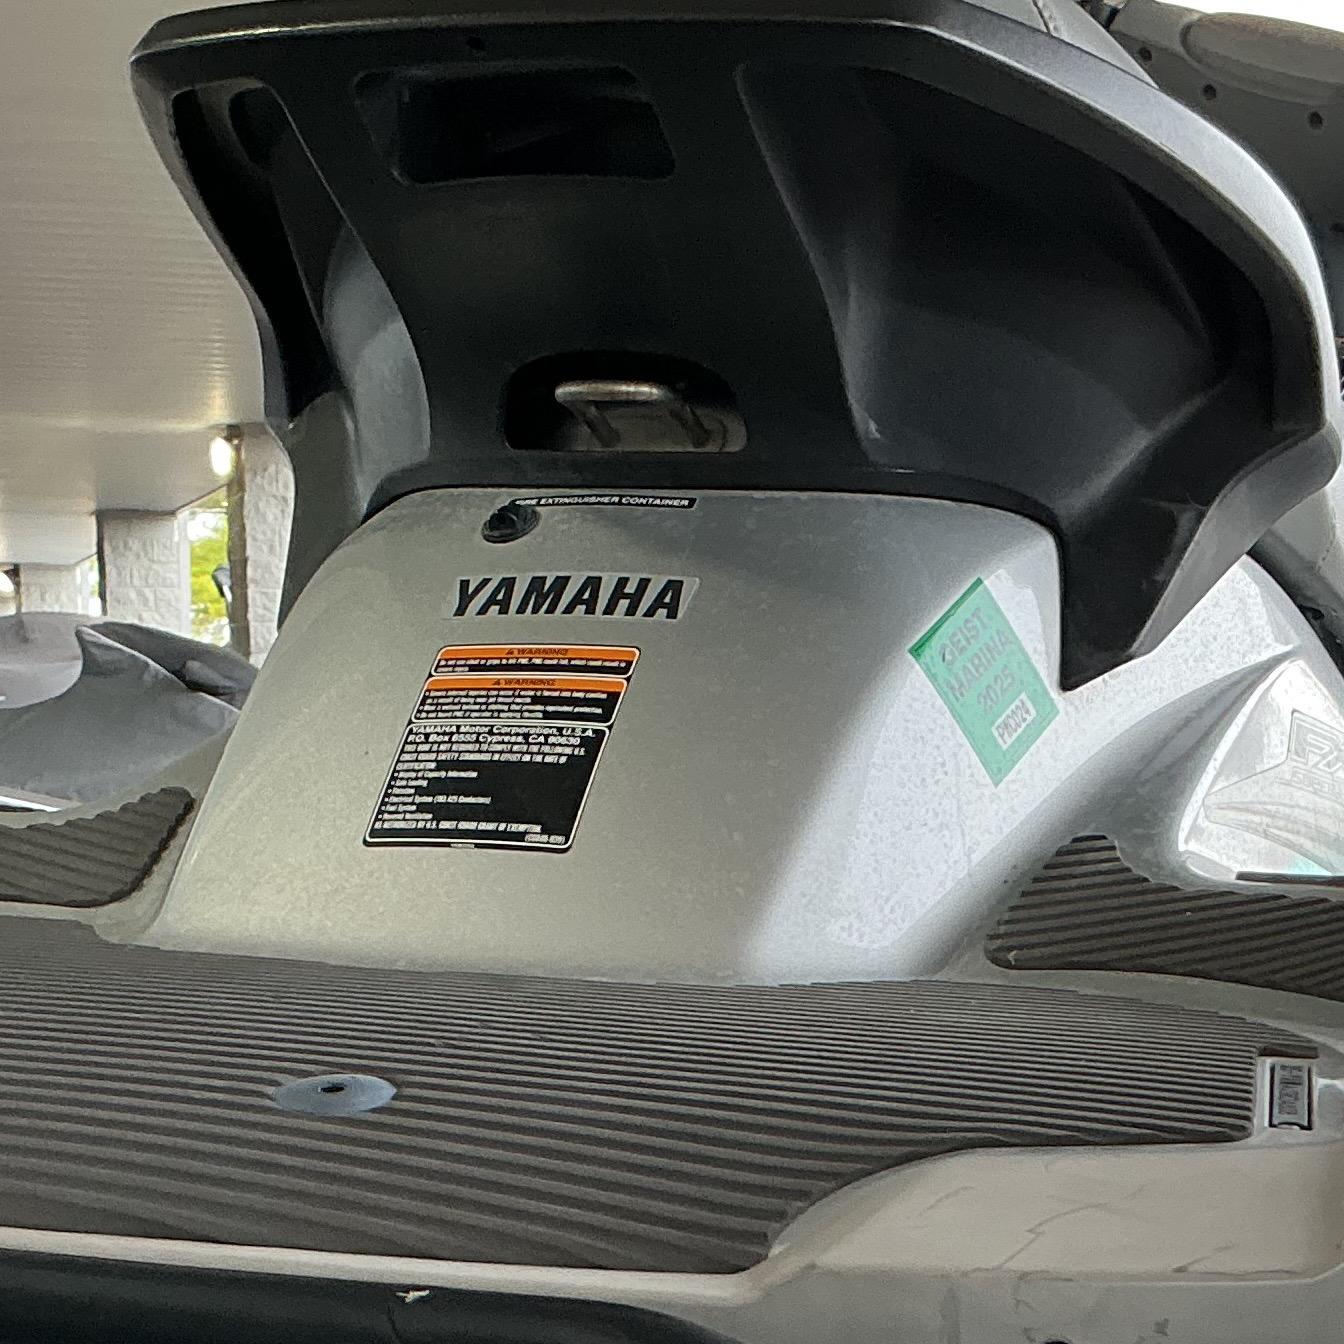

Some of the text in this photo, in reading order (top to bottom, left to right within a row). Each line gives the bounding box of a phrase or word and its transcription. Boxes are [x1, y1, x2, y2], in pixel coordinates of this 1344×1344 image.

[621, 496, 690, 506] CONTAINER
[453, 575, 684, 620] YAMAHA
[938, 607, 988, 667] GEIST
[517, 648, 568, 657] WARNING
[944, 628, 1015, 702] MARINA
[504, 679, 556, 688] WARNING
[976, 665, 1017, 714] 2025
[412, 725, 596, 738] YAMAHA Motor Corporation, U.S.A.
[428, 733, 451, 742] Box
[479, 733, 526, 745] Cypress,
[528, 734, 545, 743] CA
